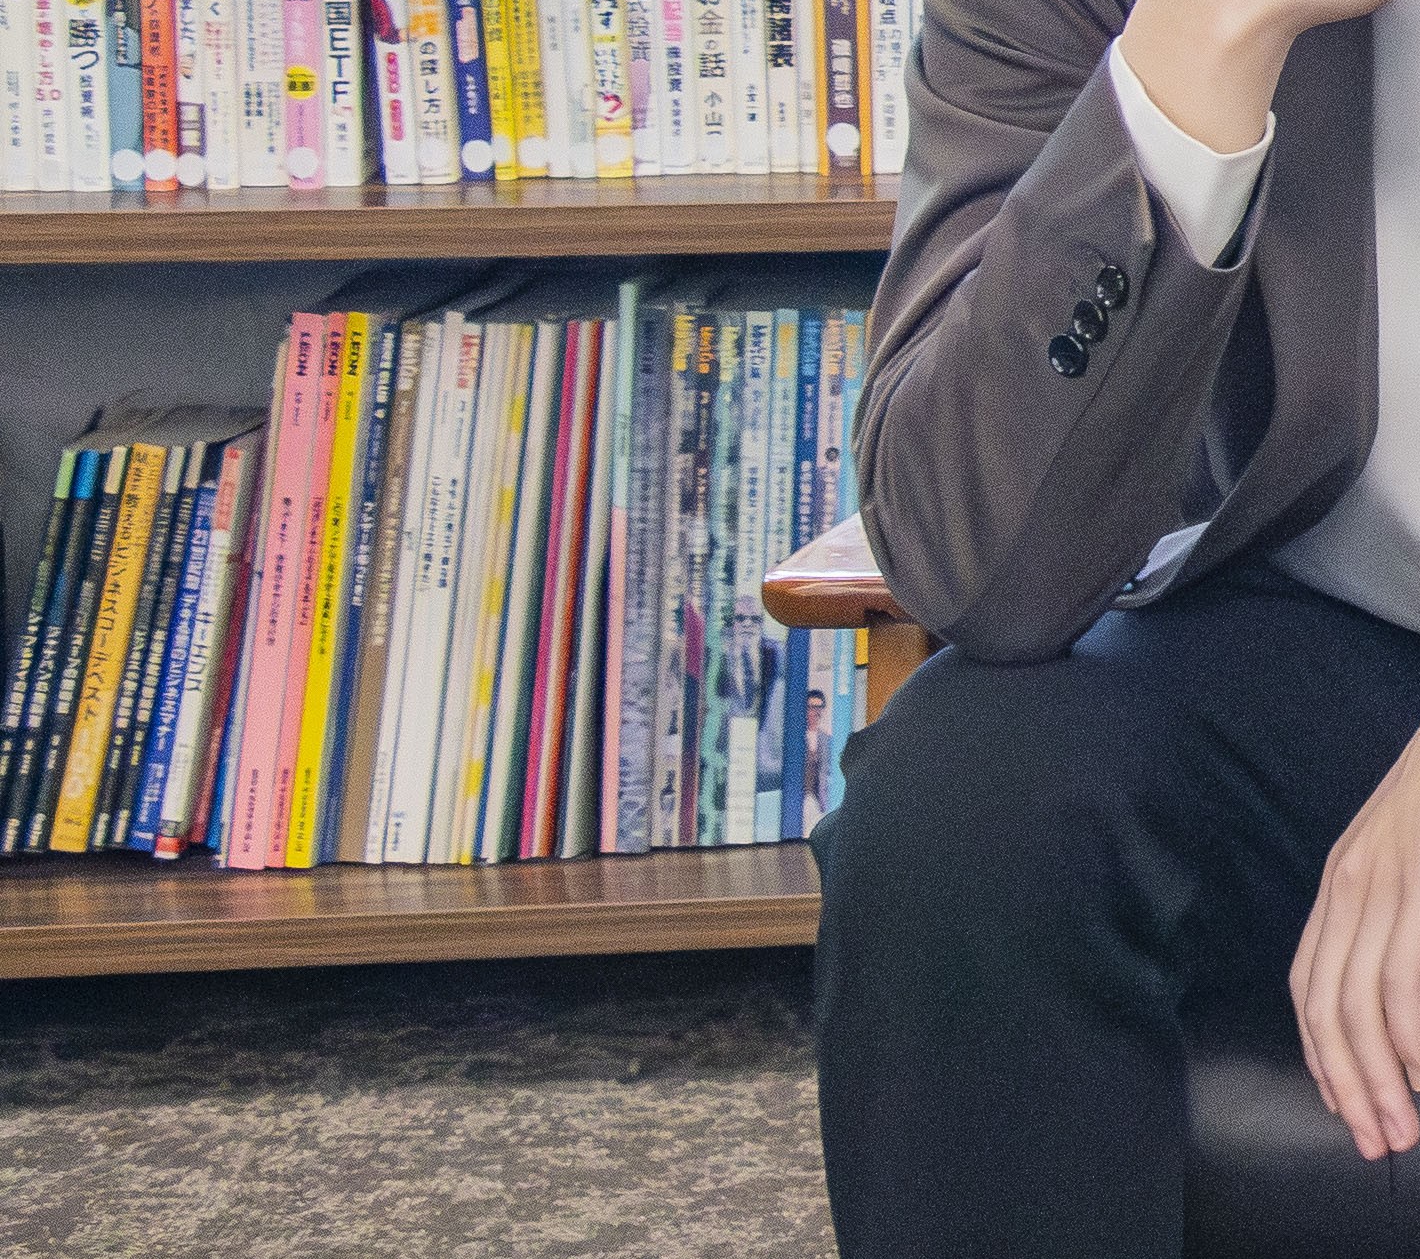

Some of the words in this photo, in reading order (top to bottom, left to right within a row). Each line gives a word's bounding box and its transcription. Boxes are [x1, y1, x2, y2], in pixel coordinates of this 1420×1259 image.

[295, 330, 311, 377] LEON
[327, 330, 342, 377] LEON
[347, 330, 362, 377] LEON
